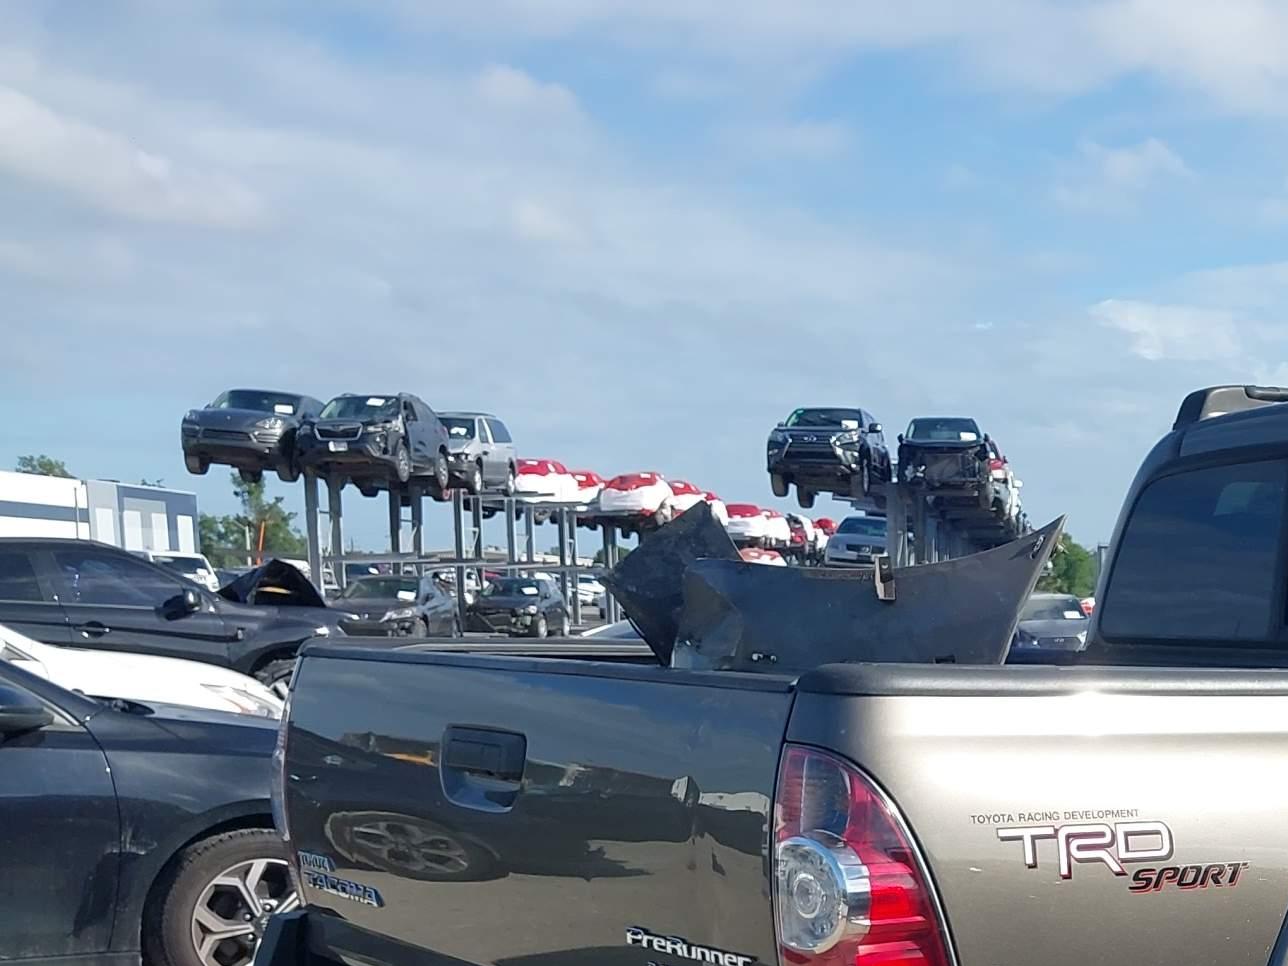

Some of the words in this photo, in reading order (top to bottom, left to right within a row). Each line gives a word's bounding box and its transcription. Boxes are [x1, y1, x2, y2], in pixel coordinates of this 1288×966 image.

[971, 813, 1014, 824] TOYOTA
[1018, 811, 1061, 822] RACING
[1064, 808, 1140, 820] DEVELOPMENT
[997, 821, 1174, 879] TRD
[1128, 860, 1250, 894] SPORT
